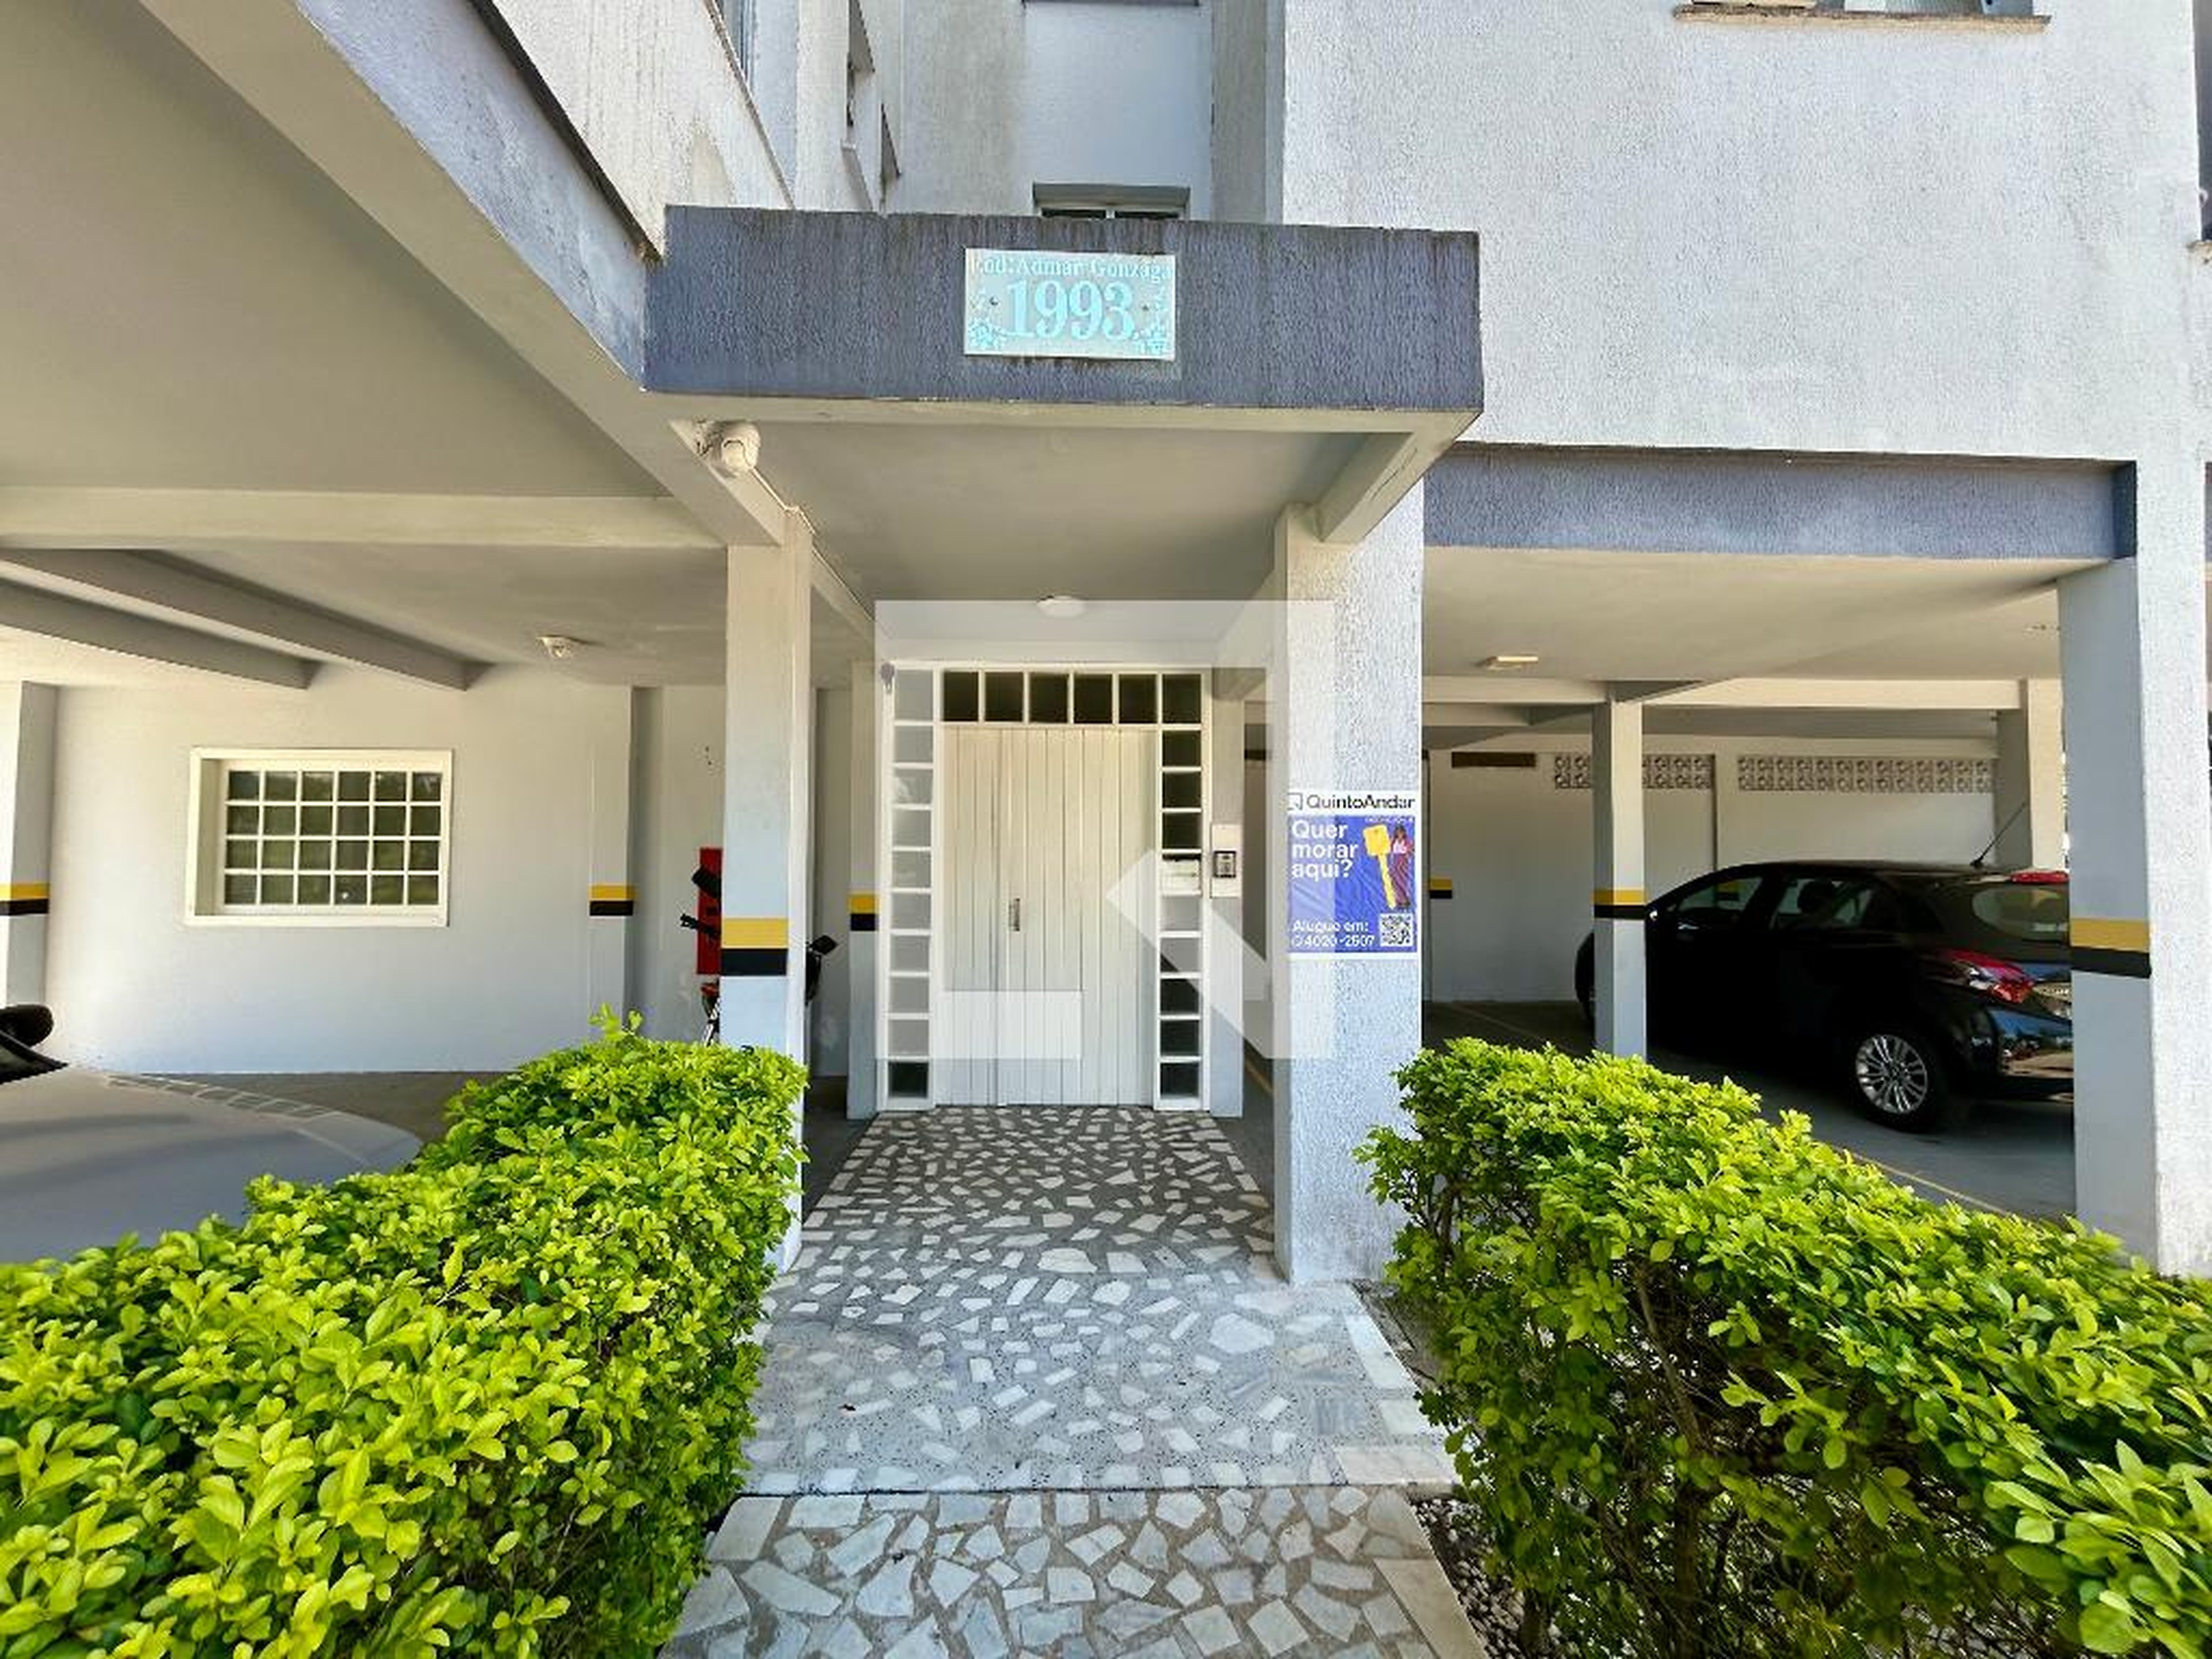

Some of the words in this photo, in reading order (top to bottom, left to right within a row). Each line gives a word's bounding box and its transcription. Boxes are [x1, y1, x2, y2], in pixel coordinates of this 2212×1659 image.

[1005, 278, 1135, 340] 1993
[1306, 794, 1415, 808] QuintoAndar
[1291, 820, 1349, 839] Quer
[1291, 843, 1358, 858] morar
[1291, 859, 1354, 882] aqui?
[1293, 920, 1341, 933] Alugue
[1343, 922, 1369, 932] em:
